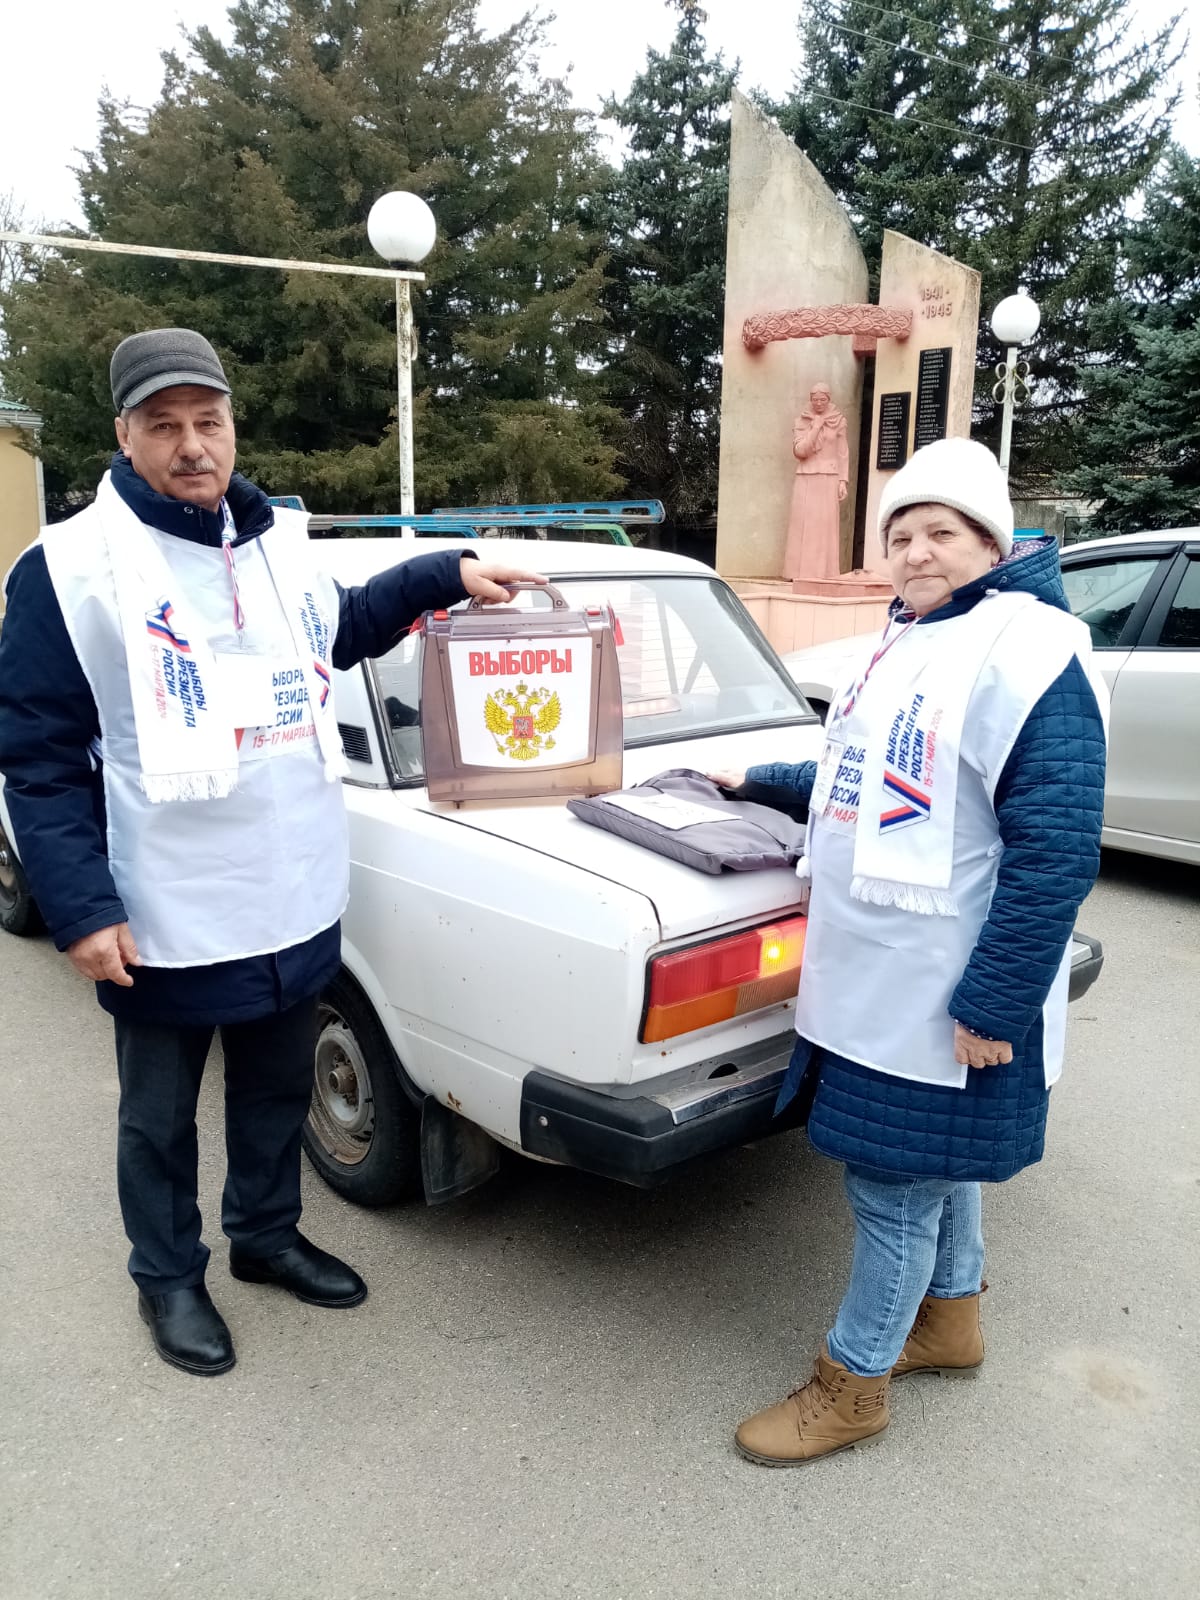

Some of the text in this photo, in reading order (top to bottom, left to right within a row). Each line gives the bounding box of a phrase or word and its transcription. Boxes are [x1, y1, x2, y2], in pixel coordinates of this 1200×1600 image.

[162, 647, 177, 697] РОССИИ
[185, 660, 208, 711] ВЫБОРЫ
[272, 668, 305, 687] ЫБОРЫ
[469, 649, 572, 676] ВЫБОРЫ
[176, 654, 197, 728] ПРЕЗИДЕНТА
[843, 745, 867, 764] ВЫБ
[886, 709, 905, 765] ВЫБОРЫ
[898, 693, 925, 774] ПРЕЗИДЕНТА
[911, 728, 925, 782] РОССИИ
[926, 730, 937, 761] МАРТА
